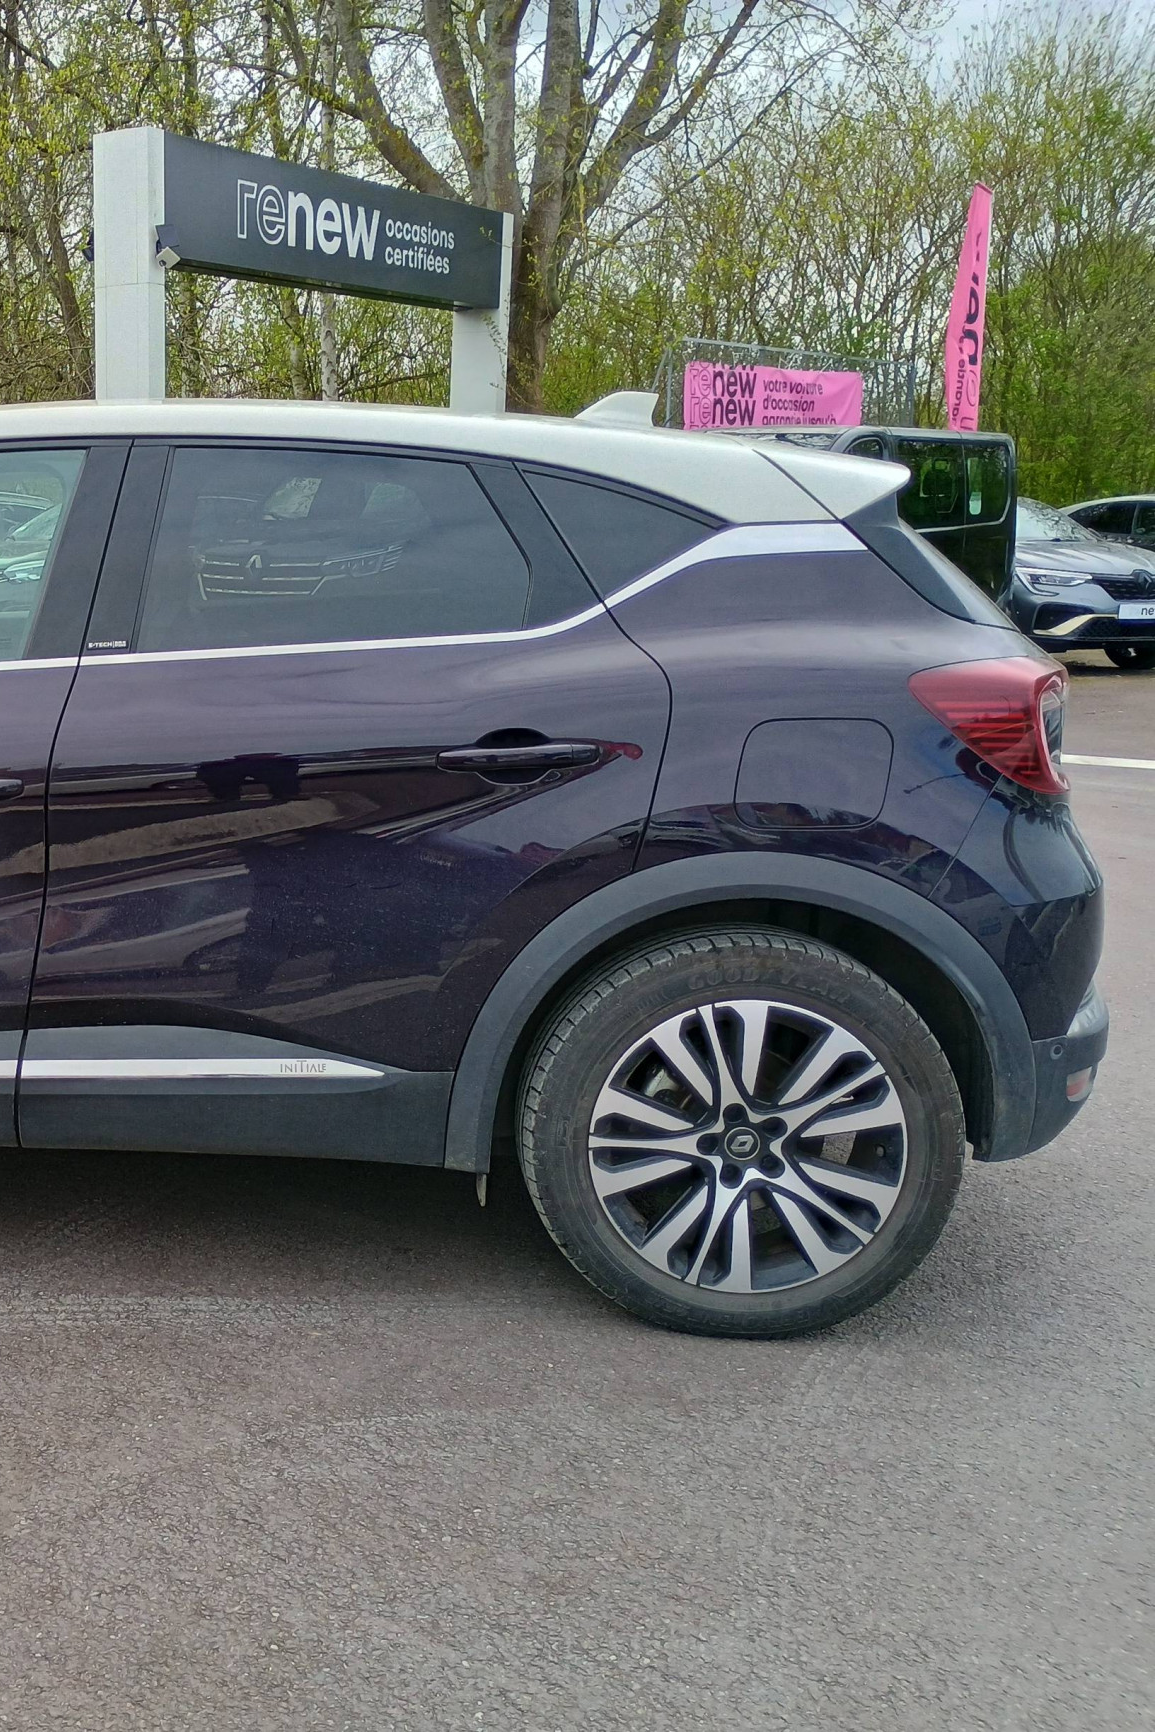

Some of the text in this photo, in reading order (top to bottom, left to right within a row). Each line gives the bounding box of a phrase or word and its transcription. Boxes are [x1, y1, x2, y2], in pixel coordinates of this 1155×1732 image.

[237, 179, 381, 261] renew
[385, 218, 455, 250] occasions
[384, 245, 450, 274] certifiées
[689, 368, 757, 399] renew
[763, 379, 788, 393] votre
[689, 397, 756, 426] renew
[763, 393, 815, 412] d'occasion
[1141, 607, 1155, 616] ne
[280, 1060, 326, 1073] INITIALE
